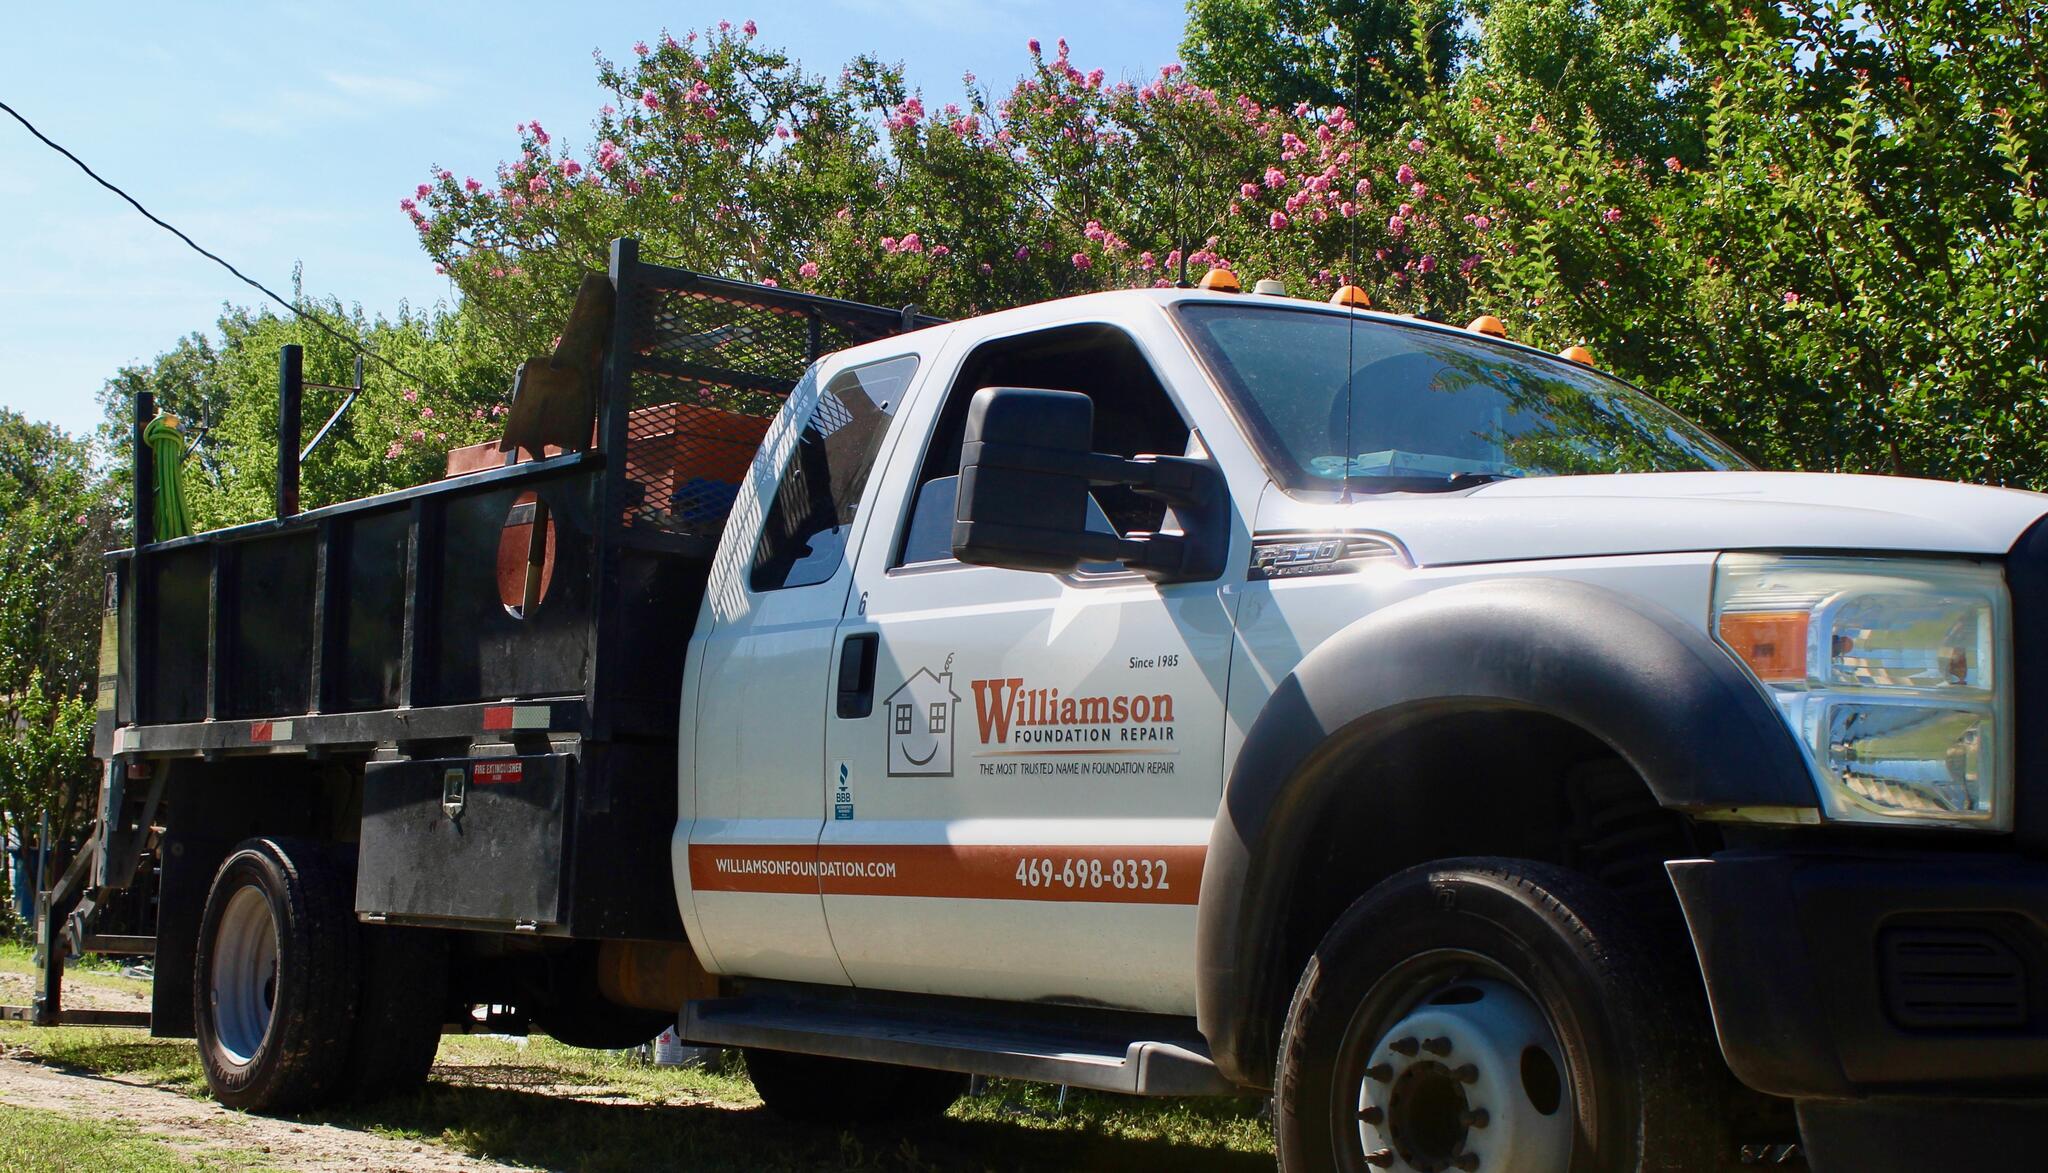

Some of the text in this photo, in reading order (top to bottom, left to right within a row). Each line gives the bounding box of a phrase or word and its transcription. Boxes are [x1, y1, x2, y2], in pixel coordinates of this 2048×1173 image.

[858, 591, 868, 616] 6
[1129, 654, 1179, 669] Since 1985
[971, 678, 1174, 744] Williamson
[1015, 727, 1174, 743] FOUNDATION REPAIR
[475, 764, 486, 774] FIRE
[979, 761, 1175, 775] THE MOST TRUSTED NAME IN FOUNDATION REPAIR
[836, 792, 851, 803] BBB
[715, 858, 896, 878] WILLIAMSONFOUNDATION.COM
[1015, 858, 1170, 890] 469-698-8332
